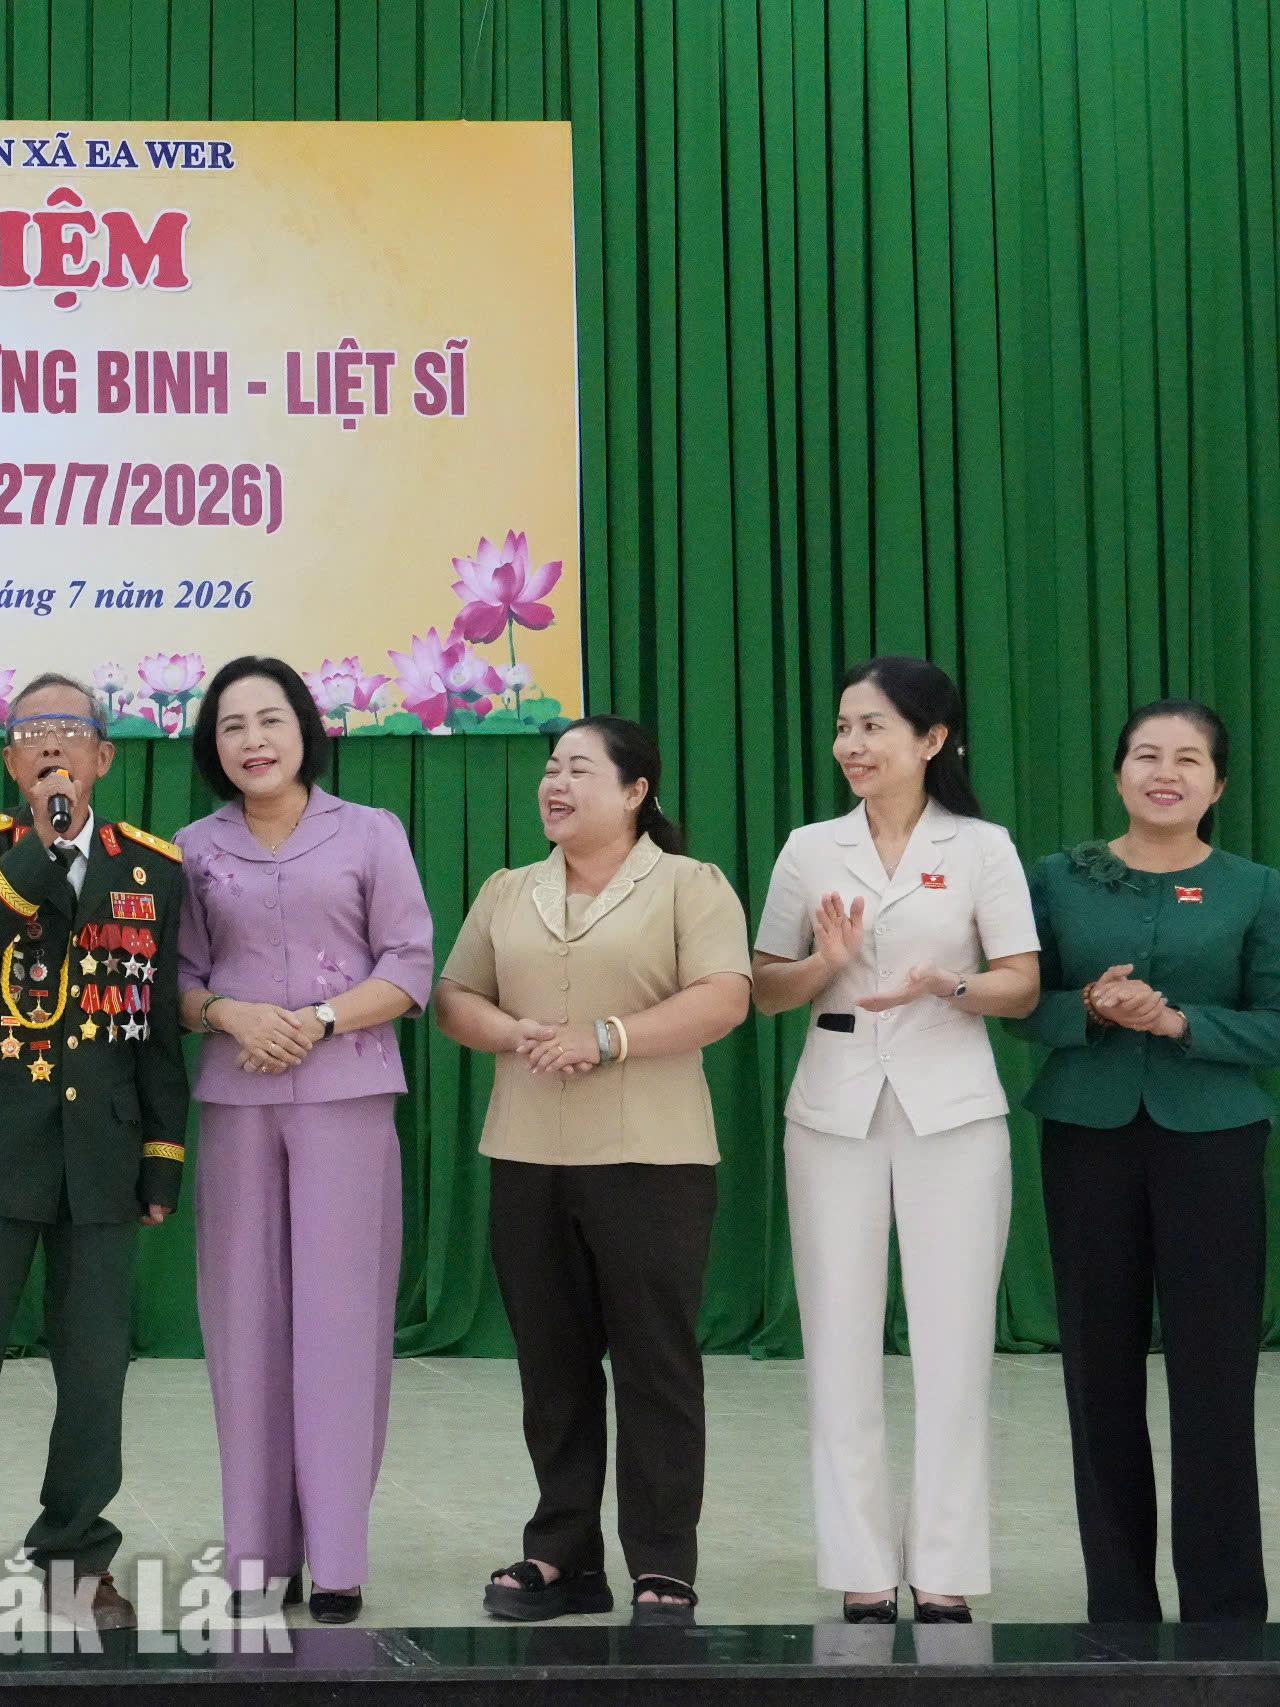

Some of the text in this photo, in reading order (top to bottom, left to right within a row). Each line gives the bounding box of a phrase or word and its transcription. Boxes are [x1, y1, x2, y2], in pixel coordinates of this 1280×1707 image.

[23, 132, 76, 168] XÃ
[86, 140, 139, 168] EA
[145, 141, 234, 169] WER
[98, 350, 228, 414] BINH
[248, 381, 267, 394] -
[287, 338, 395, 429] LIỆT
[414, 339, 469, 415] SĨ
[67, 580, 86, 608] 7
[95, 579, 164, 609] năm
[174, 579, 253, 609] 2026
